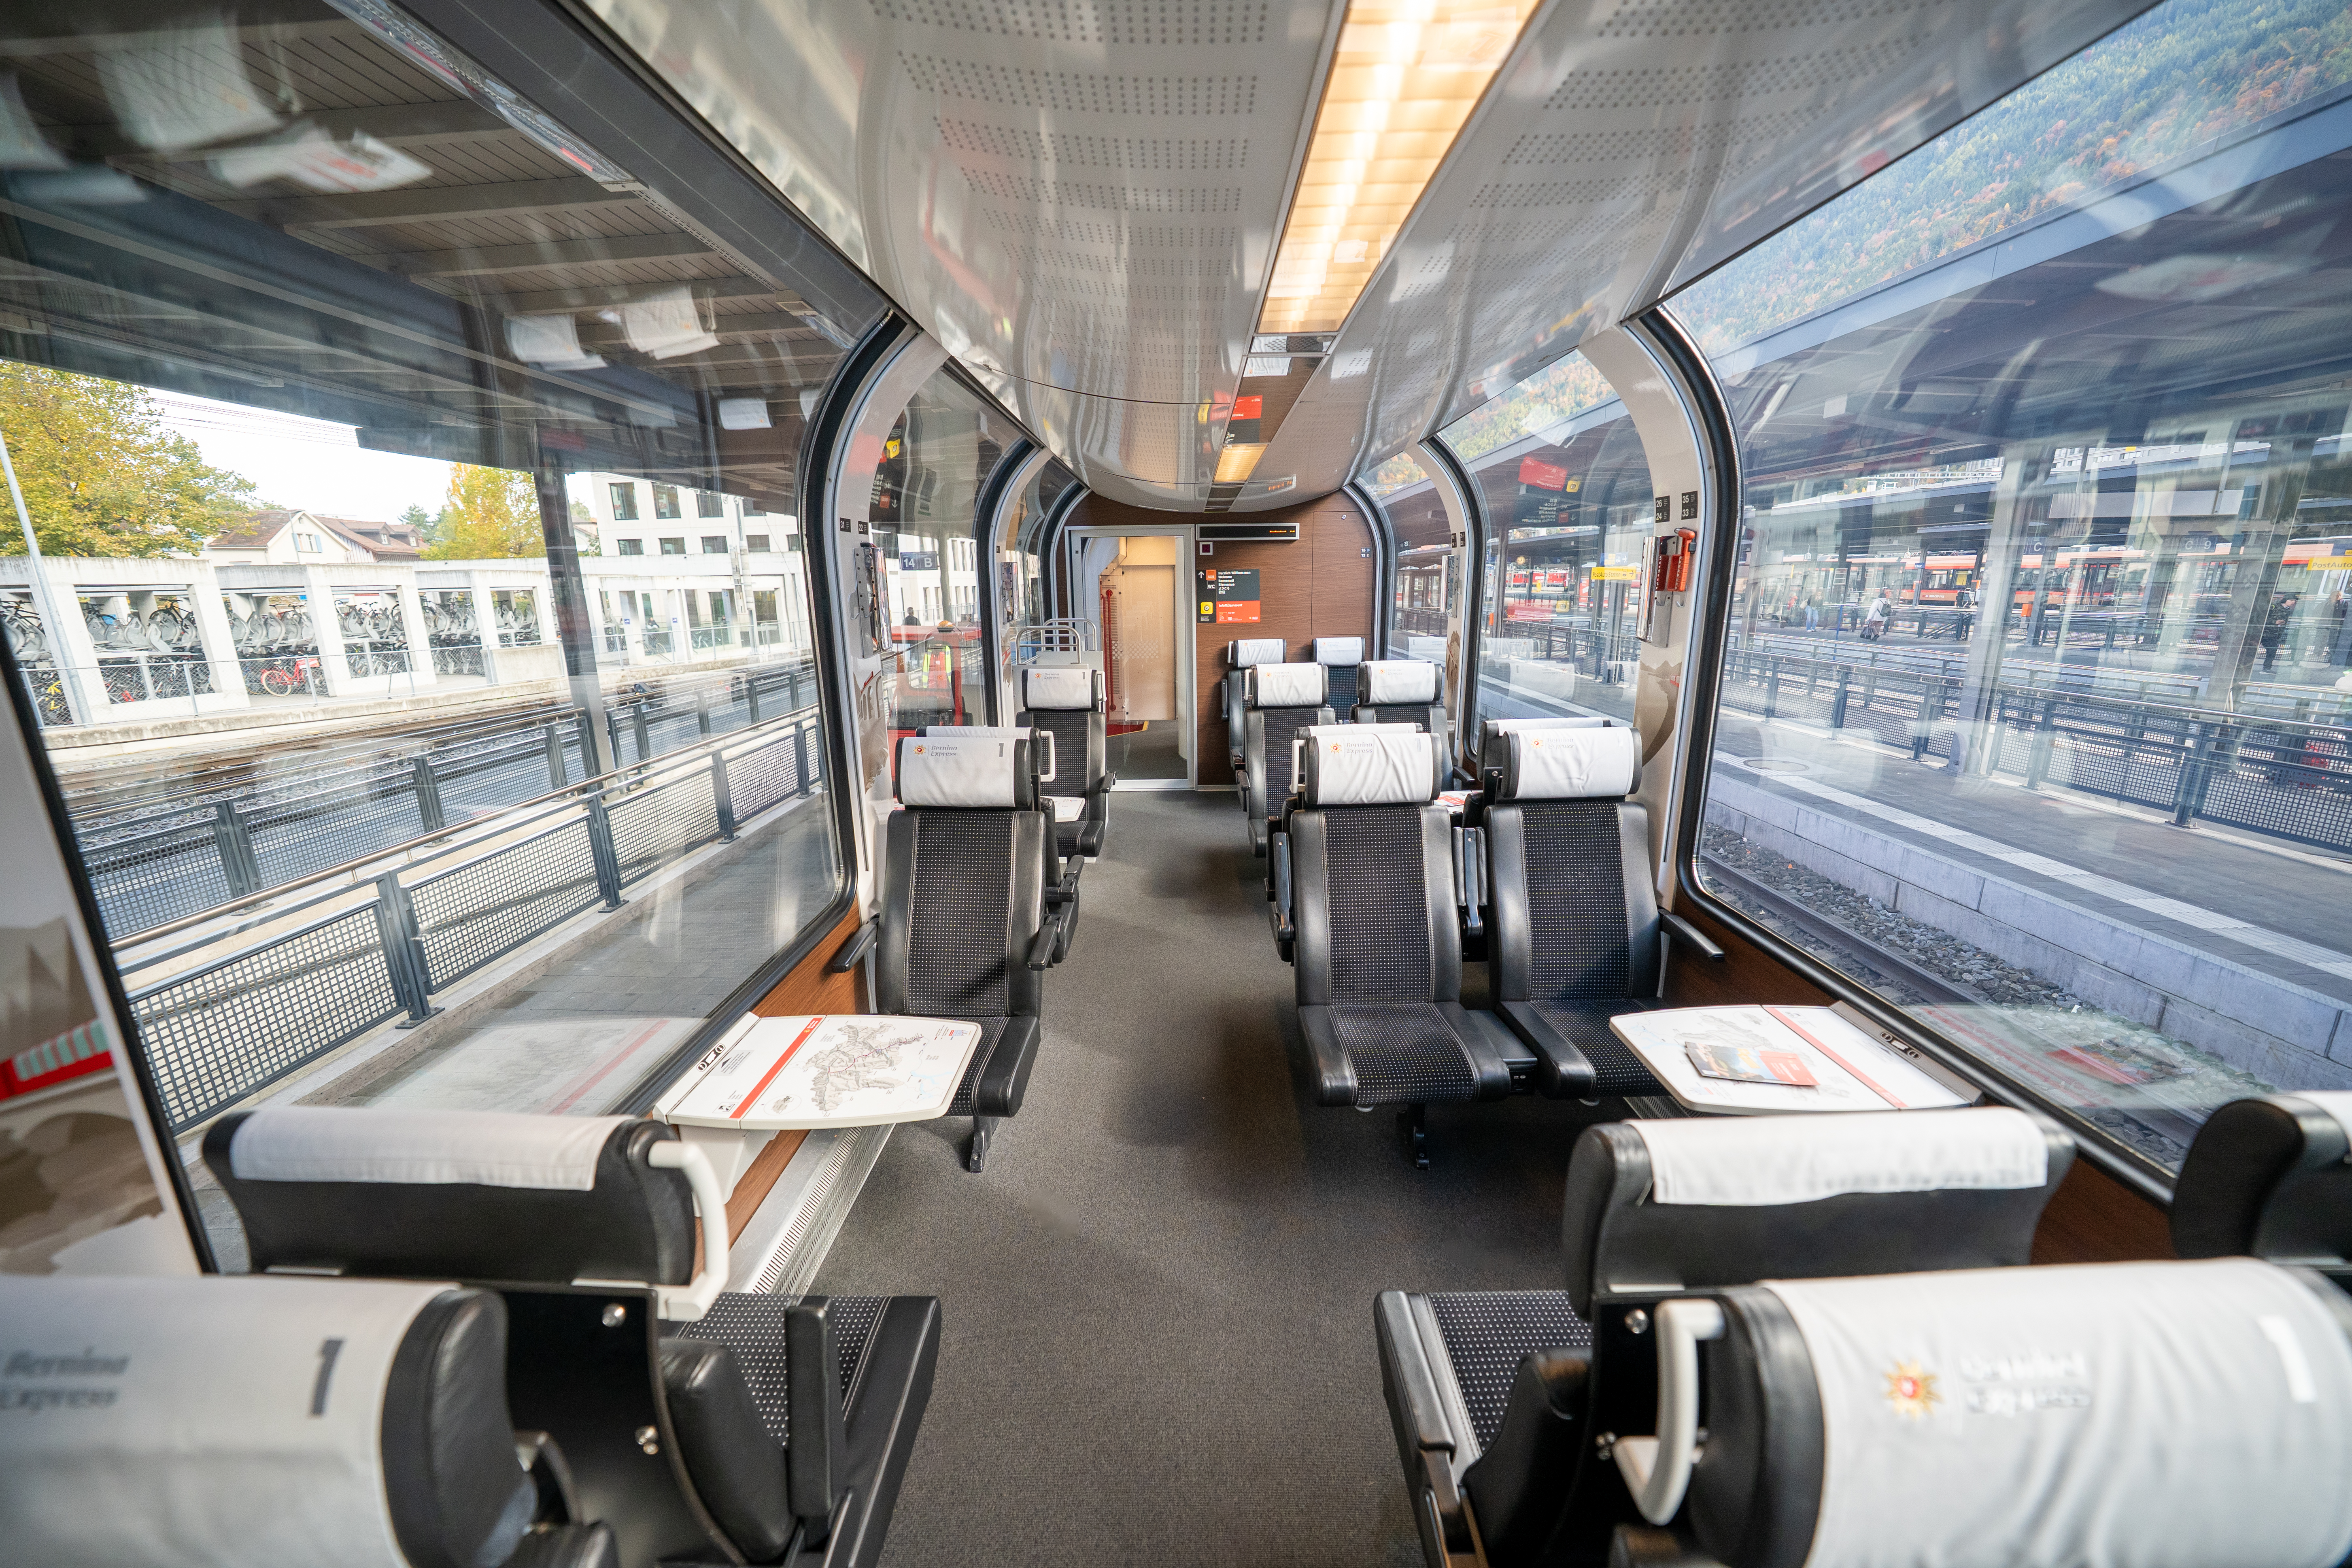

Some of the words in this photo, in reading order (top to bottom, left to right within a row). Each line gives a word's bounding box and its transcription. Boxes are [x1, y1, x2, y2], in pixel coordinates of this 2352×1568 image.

[1656, 499, 1662, 508] 26
[1682, 495, 1689, 504] 35
[1682, 509, 1689, 517] 33
[2033, 542, 2042, 552] C
[2185, 540, 2193, 550] C
[2203, 540, 2212, 550] 9
[903, 558, 915, 567] 14
[924, 558, 933, 567] B
[999, 743, 1004, 757] 1
[1415, 738, 1421, 752] 1
[2259, 1316, 2318, 1403] 1
[308, 1338, 345, 1417] 1
